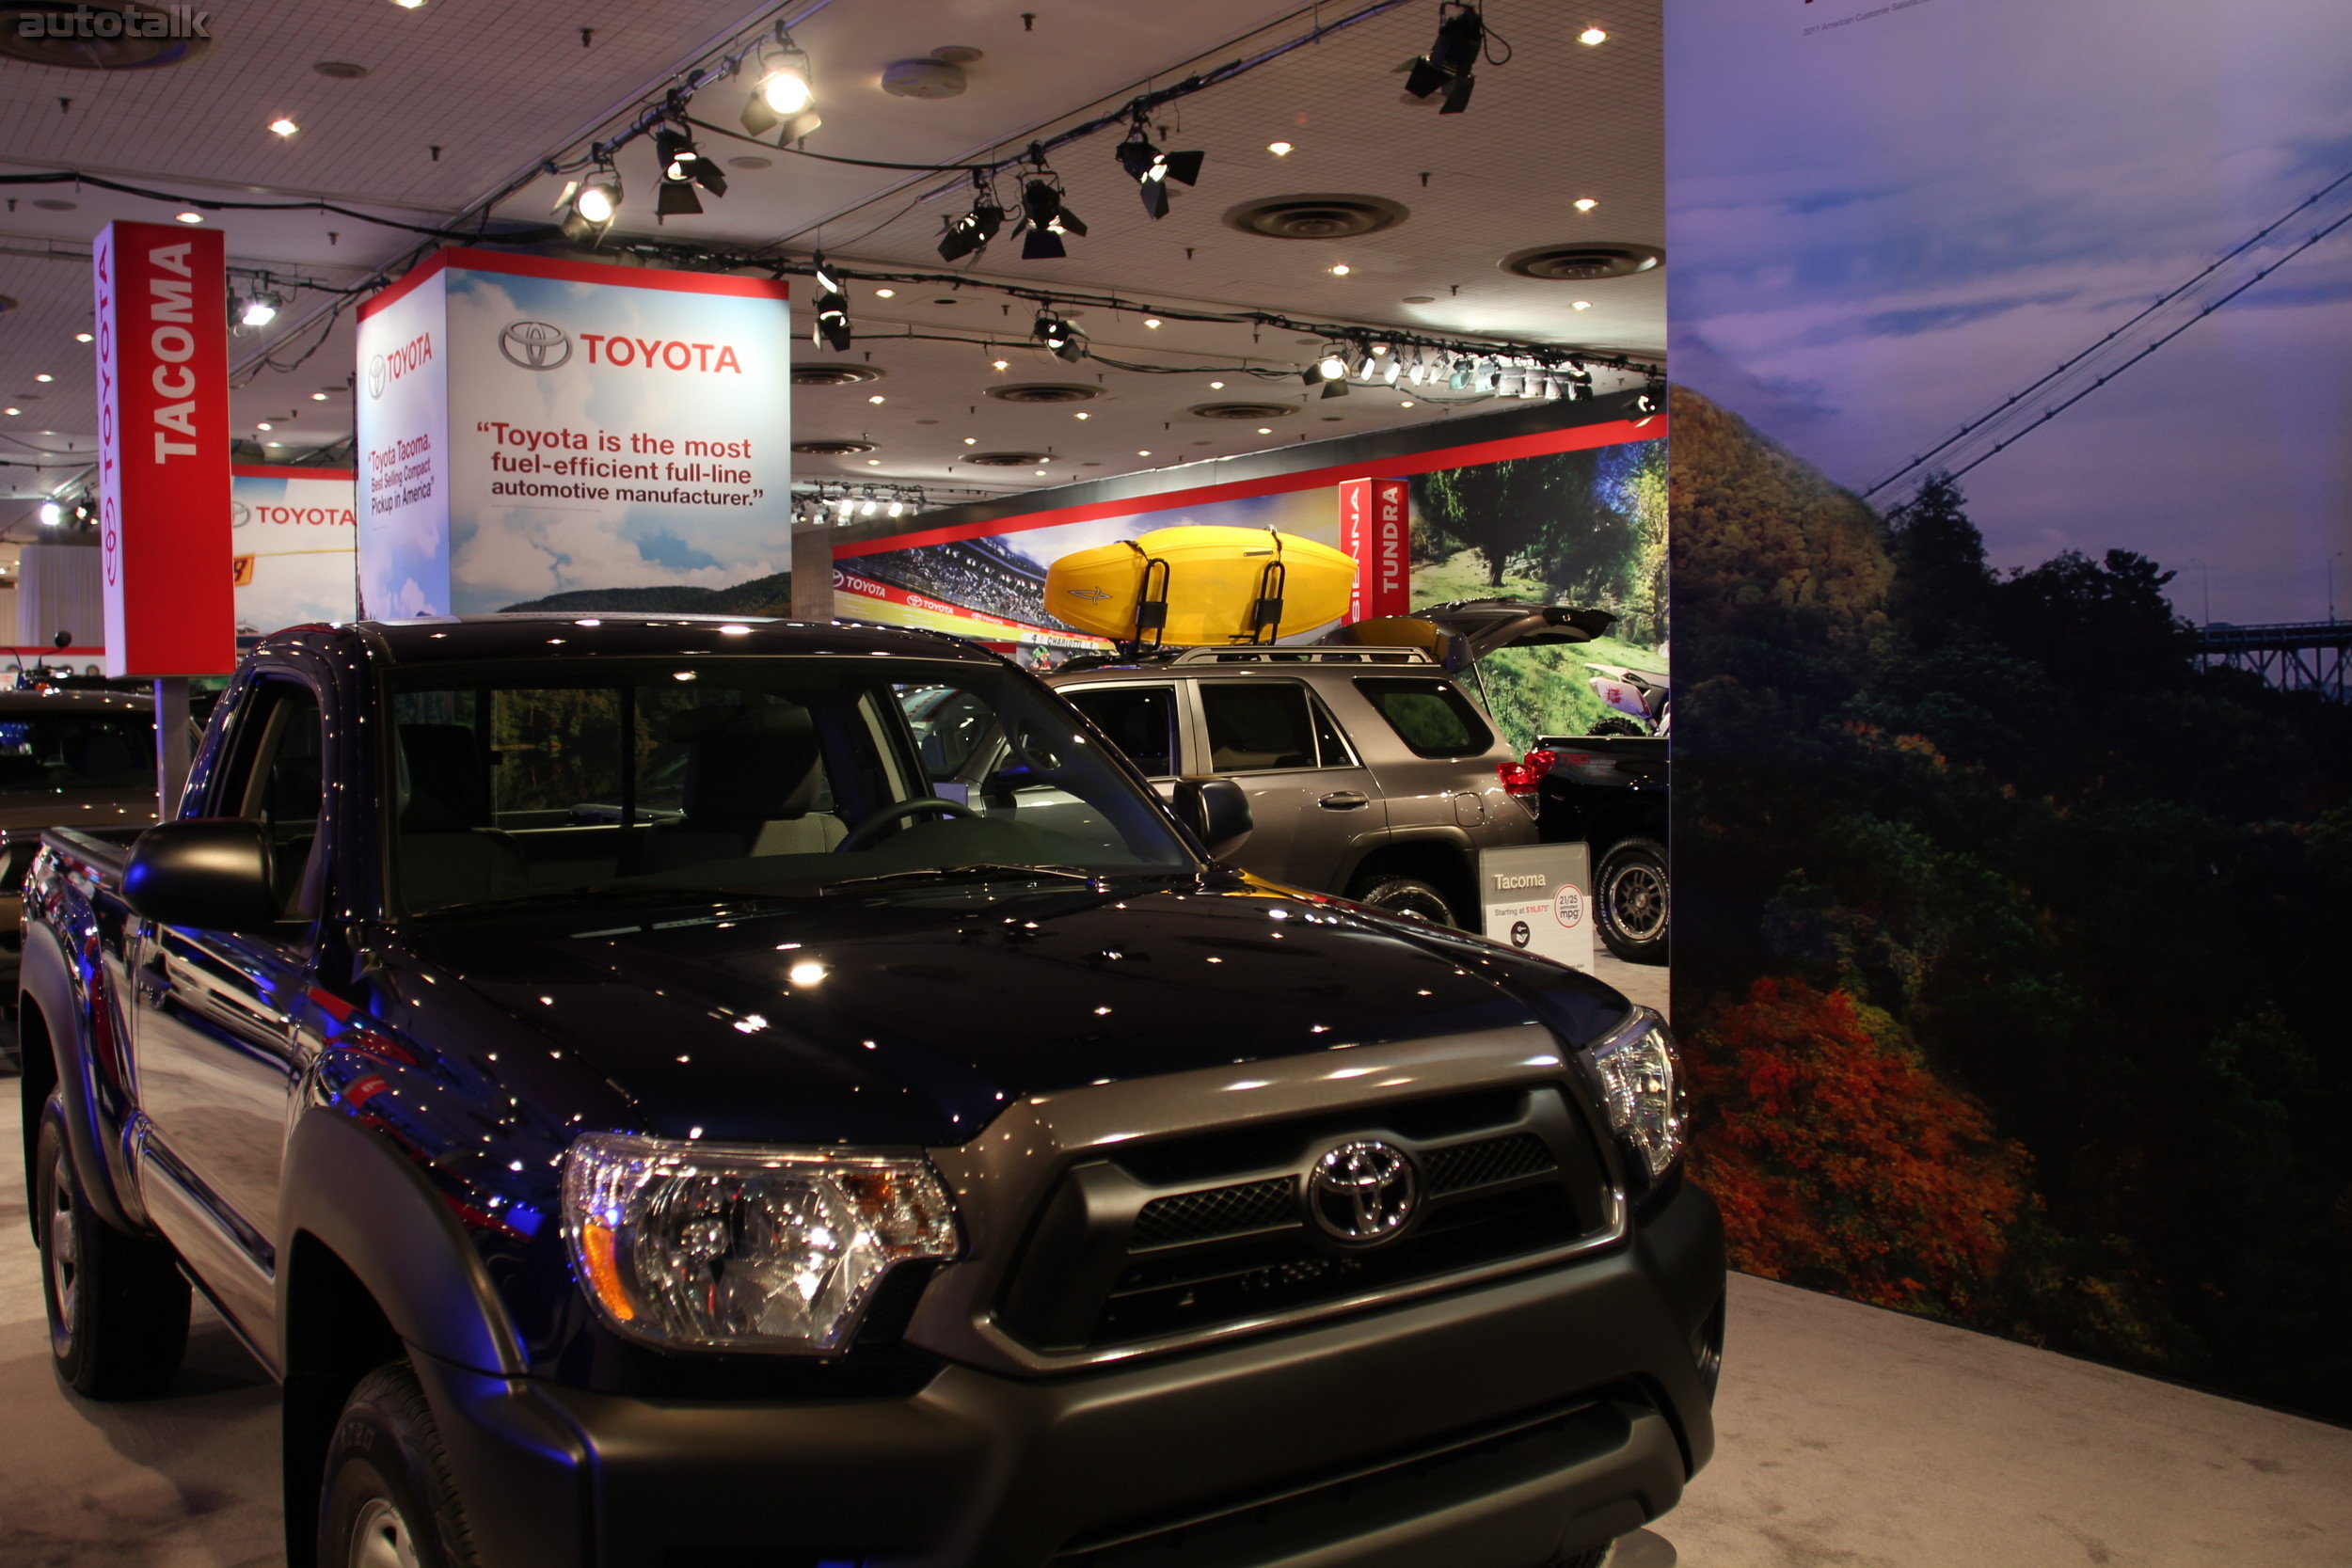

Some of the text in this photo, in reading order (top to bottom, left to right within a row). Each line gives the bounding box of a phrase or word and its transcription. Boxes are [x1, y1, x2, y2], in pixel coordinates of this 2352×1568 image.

[1803, 24, 1820, 37] 2011
[1821, 16, 1854, 31] American
[1855, 7, 1890, 22] Customer
[98, 243, 114, 484] TOYOTA
[149, 241, 197, 465] TACOMA
[387, 332, 433, 383] TOYOTA
[580, 333, 742, 374] TOYOTA
[598, 428, 622, 452] is
[630, 431, 675, 455] the
[685, 436, 752, 459] most
[371, 458, 431, 493] Best Selling Compact
[491, 451, 752, 484] fuel-efficient full-line
[372, 492, 393, 515] Pickup
[394, 489, 402, 504] in
[491, 480, 610, 501] automotive
[255, 506, 357, 527] TOYOTA
[1382, 486, 1399, 594] TUNDRA
[846, 575, 886, 599] TOYOTA
[923, 600, 954, 616] TOYOTA
[983, 615, 1004, 626] TOYOTA
[1558, 753, 1591, 767] TRD
[1494, 874, 1547, 890] Tacoma
[1495, 908, 1518, 917] Starting
[1559, 895, 1578, 905] 21/25
[1560, 910, 1579, 920] mpg
